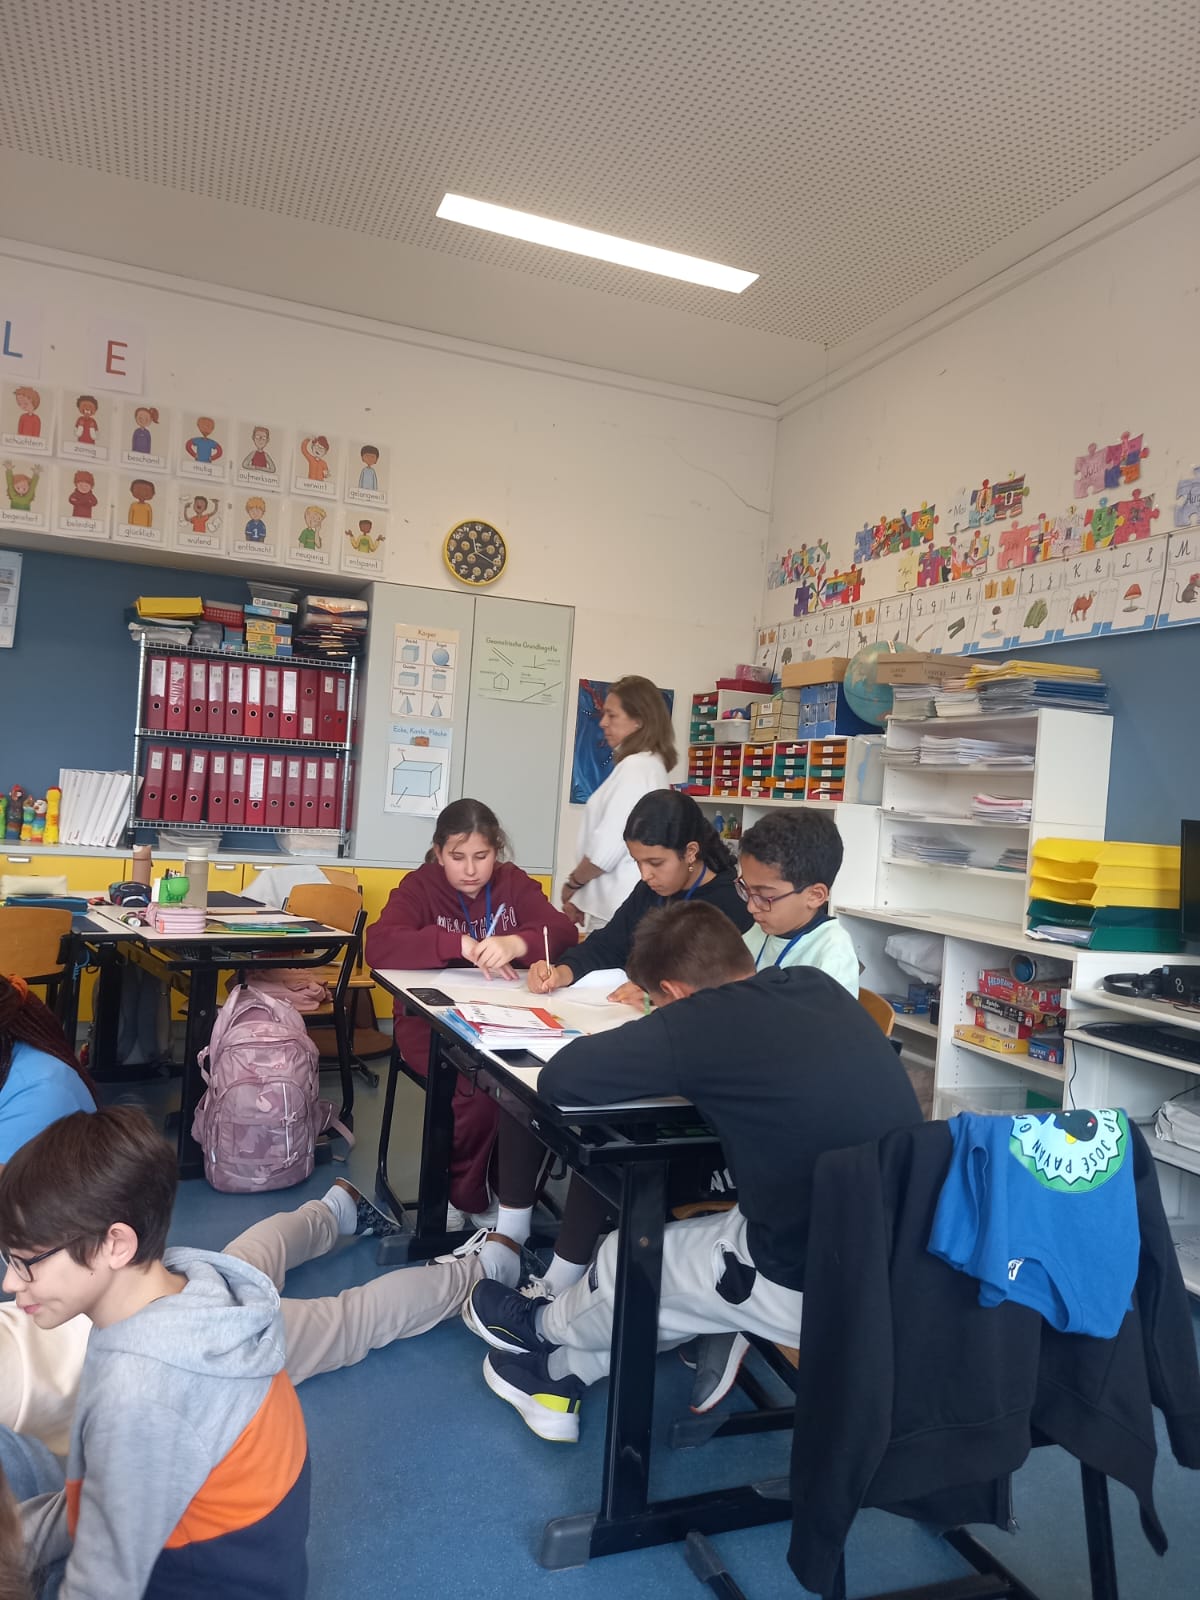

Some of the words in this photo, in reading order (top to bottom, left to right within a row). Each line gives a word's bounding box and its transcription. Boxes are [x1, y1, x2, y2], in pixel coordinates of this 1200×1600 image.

[3, 321, 23, 358] L
[106, 340, 128, 376] E
[239, 472, 278, 484] aufmerksam
[125, 528, 155, 538] glücklich
[1175, 540, 1191, 558] M
[295, 551, 324, 562] neugierig
